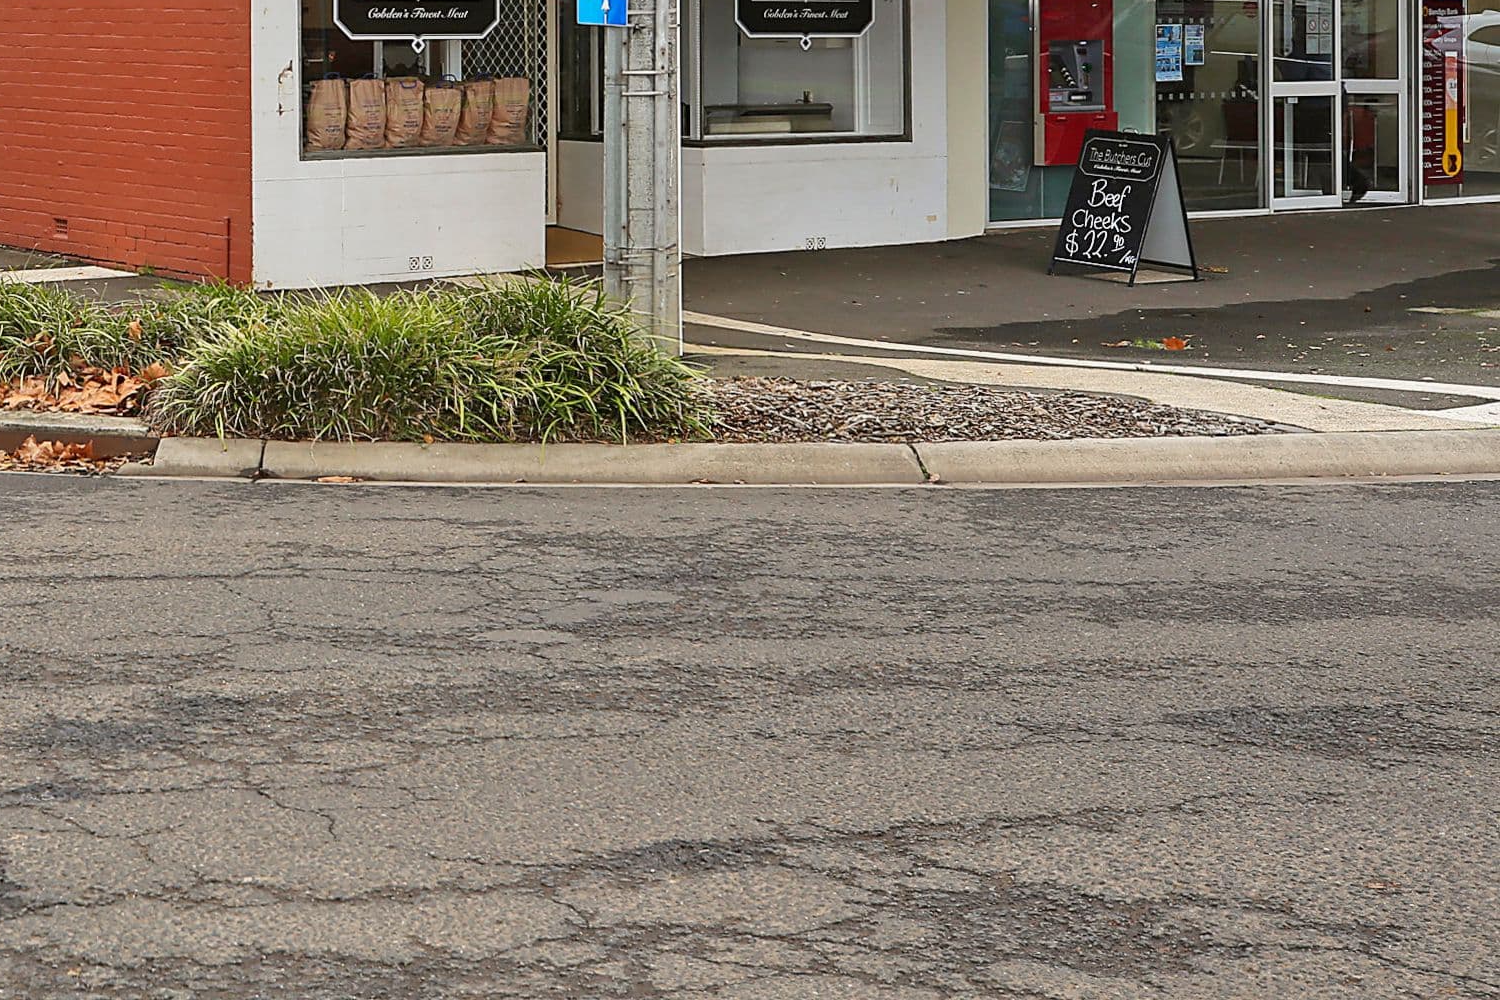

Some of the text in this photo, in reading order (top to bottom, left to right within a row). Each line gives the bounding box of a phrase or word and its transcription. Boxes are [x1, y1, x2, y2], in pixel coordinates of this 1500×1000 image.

[367, 7, 409, 19] Cobden's
[410, 7, 442, 19] Finest
[1089, 147, 1104, 162] The
[1104, 149, 1137, 165] Butchers
[1088, 178, 1131, 212] Beef
[1072, 209, 1132, 233] Cheeks
